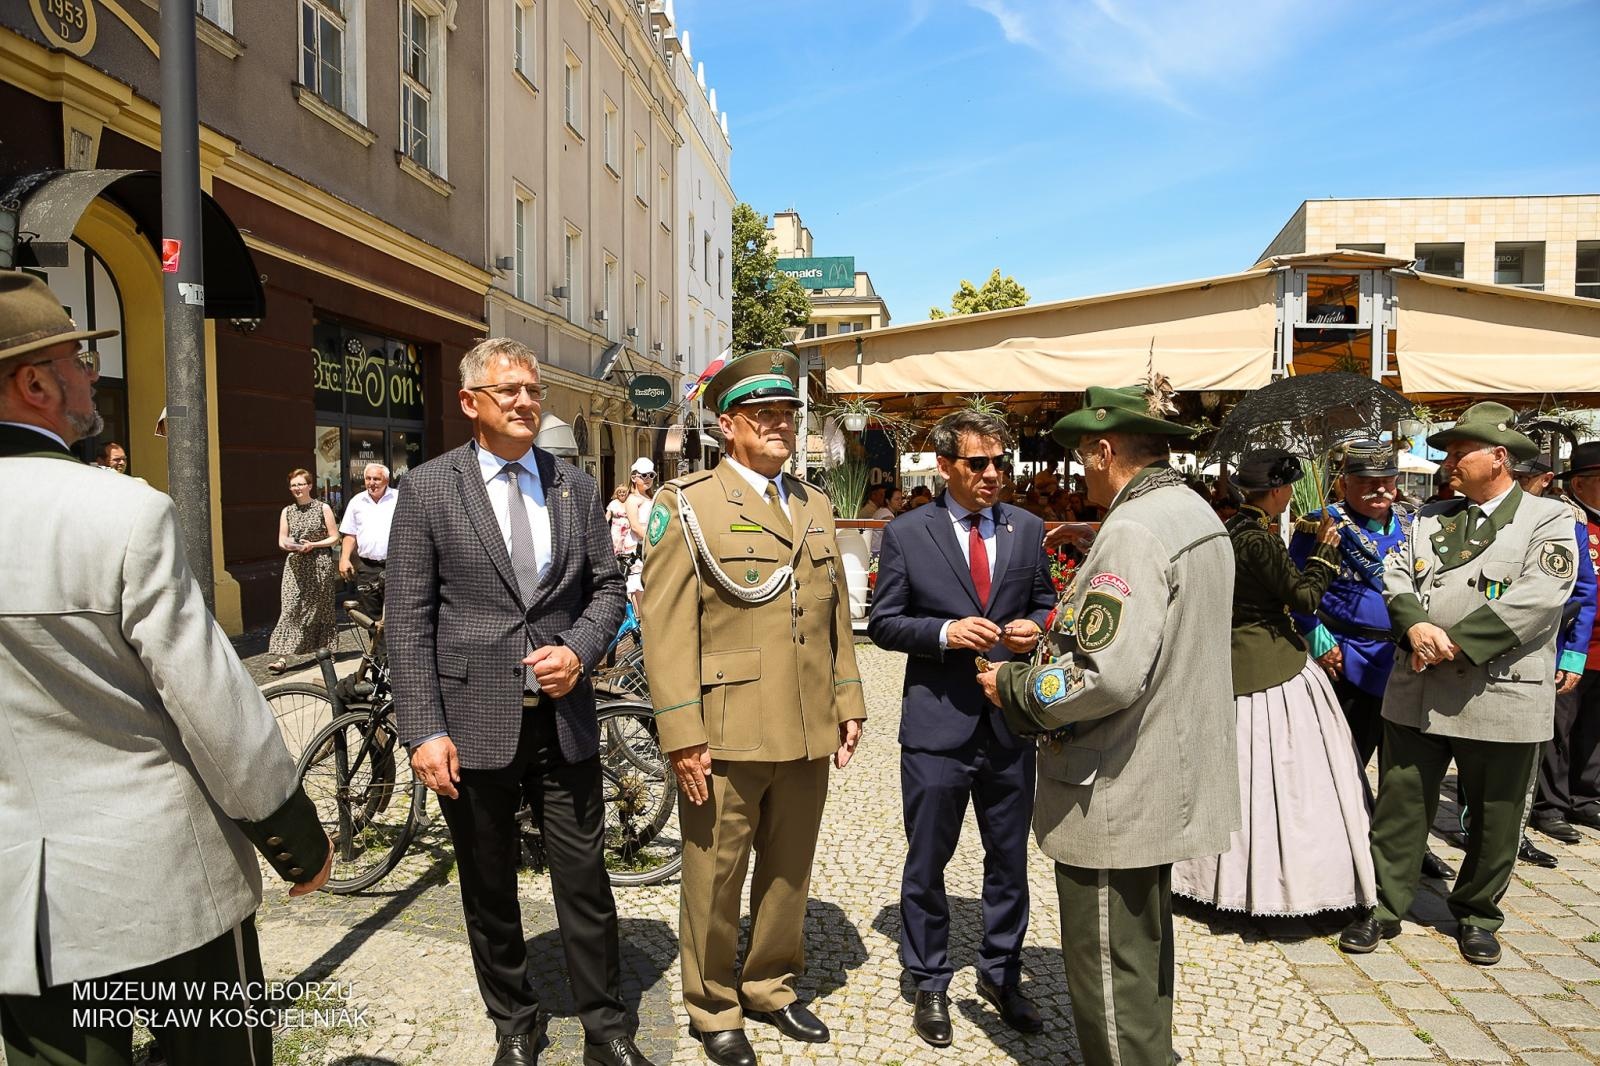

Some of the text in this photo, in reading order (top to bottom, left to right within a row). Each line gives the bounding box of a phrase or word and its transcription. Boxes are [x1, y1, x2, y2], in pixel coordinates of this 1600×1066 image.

[47, 0, 84, 29] 1953
[61, 22, 69, 39] D
[1093, 575, 1129, 593] POLAND
